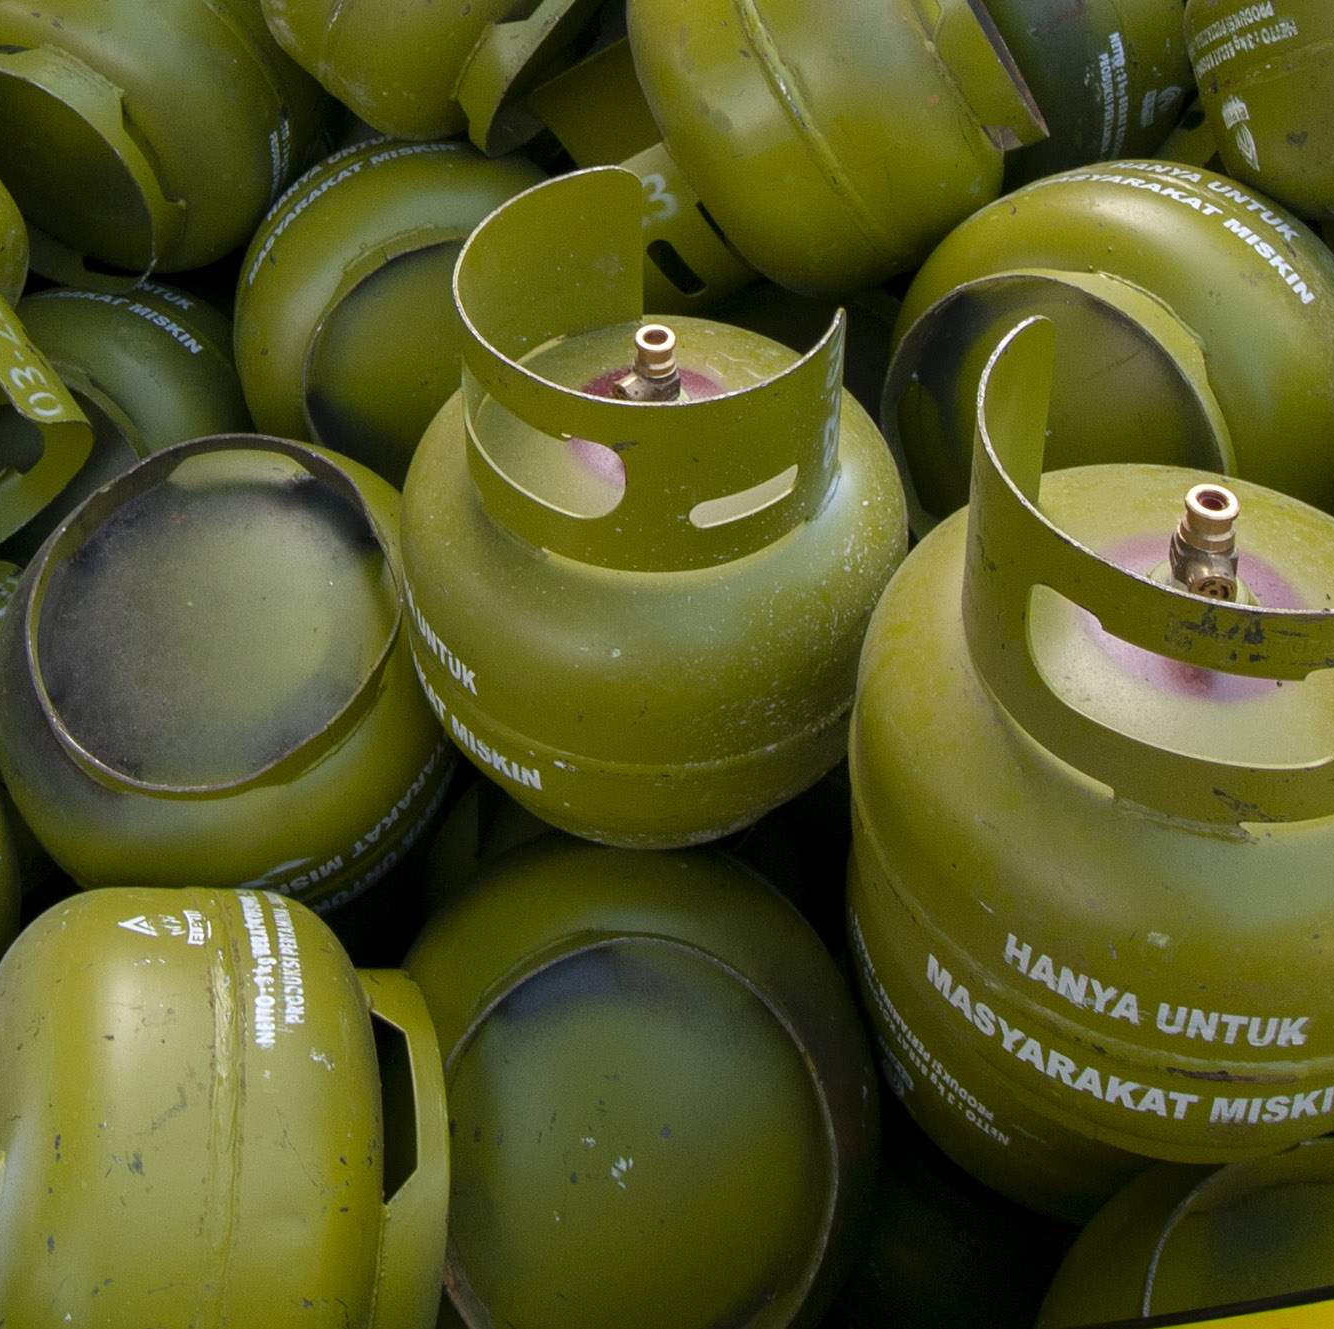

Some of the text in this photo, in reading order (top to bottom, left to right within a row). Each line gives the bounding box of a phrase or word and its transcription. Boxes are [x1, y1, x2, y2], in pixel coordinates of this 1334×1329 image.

[369, 141, 457, 169] MISKIN
[1206, 179, 1301, 243] UNTUK
[1222, 215, 1317, 306] MISKIN
[415, 607, 479, 697] UNTUK
[449, 715, 544, 791] MISKIN
[1003, 932, 1313, 1048] HANYA UNTUK
[925, 952, 1200, 1123] MASYARAKAT
[931, 1058, 995, 1124] PRODUKSI
[965, 1109, 1011, 1147] NETTO
